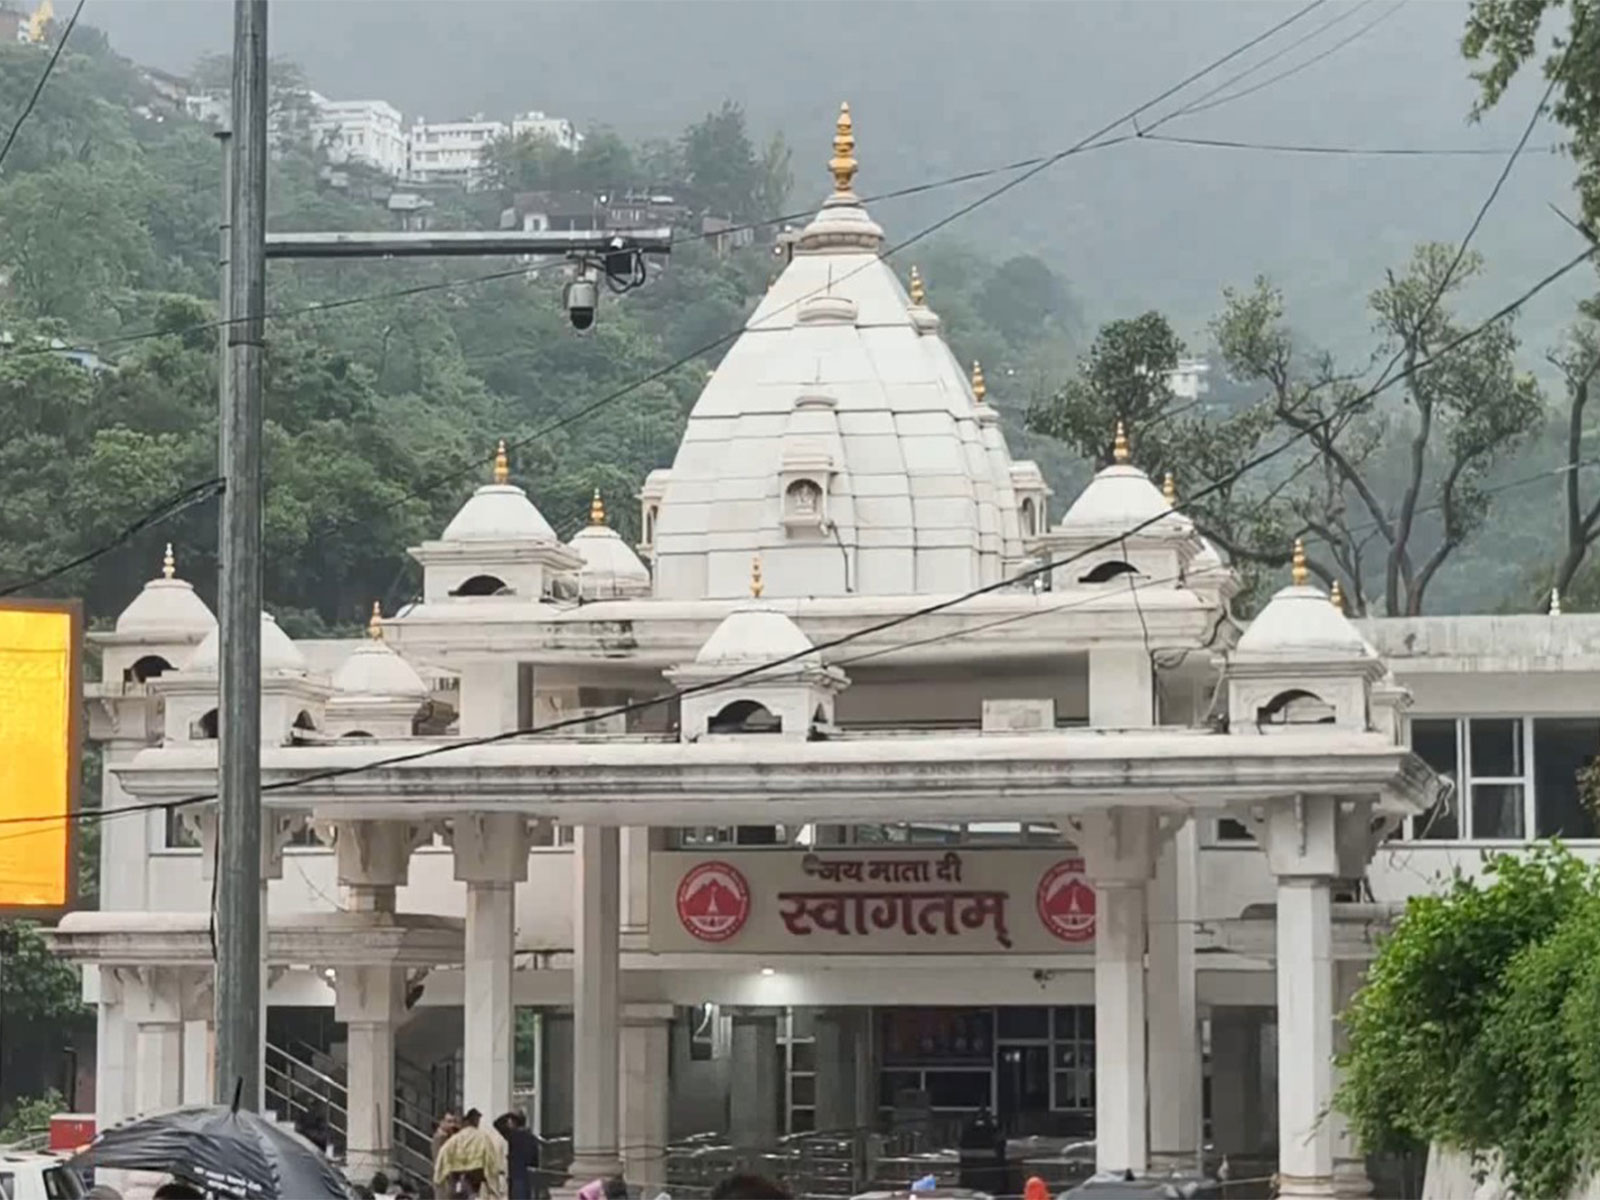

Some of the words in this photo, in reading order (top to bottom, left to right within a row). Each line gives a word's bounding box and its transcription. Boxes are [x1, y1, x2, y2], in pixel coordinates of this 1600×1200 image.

[818, 860, 865, 882] जय
[868, 860, 930, 883] माता
[936, 852, 962, 883] दी
[778, 892, 1012, 949] स्वागतम्
